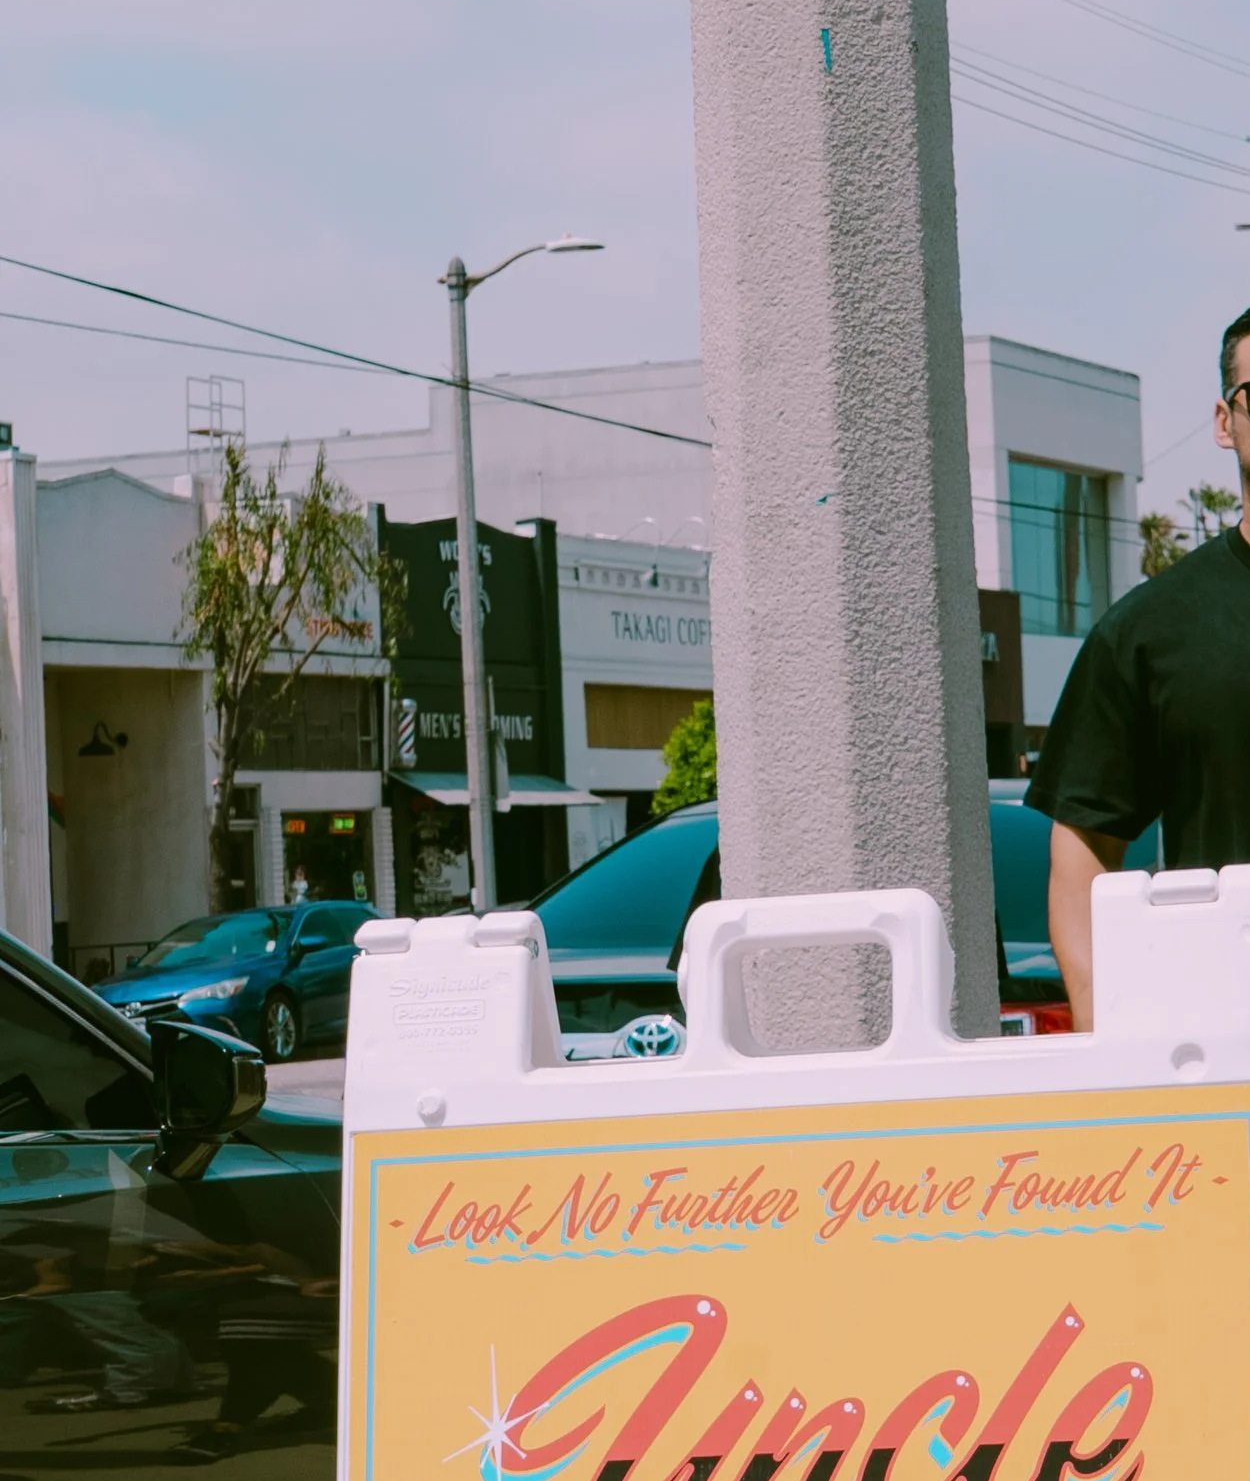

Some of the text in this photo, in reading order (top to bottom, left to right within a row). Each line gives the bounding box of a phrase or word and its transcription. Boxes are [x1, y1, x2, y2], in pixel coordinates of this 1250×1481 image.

[611, 610, 711, 646] TAKAGI COF
[420, 713, 461, 739] MEN'S
[408, 1143, 1202, 1254] Look No Further You've Found It
